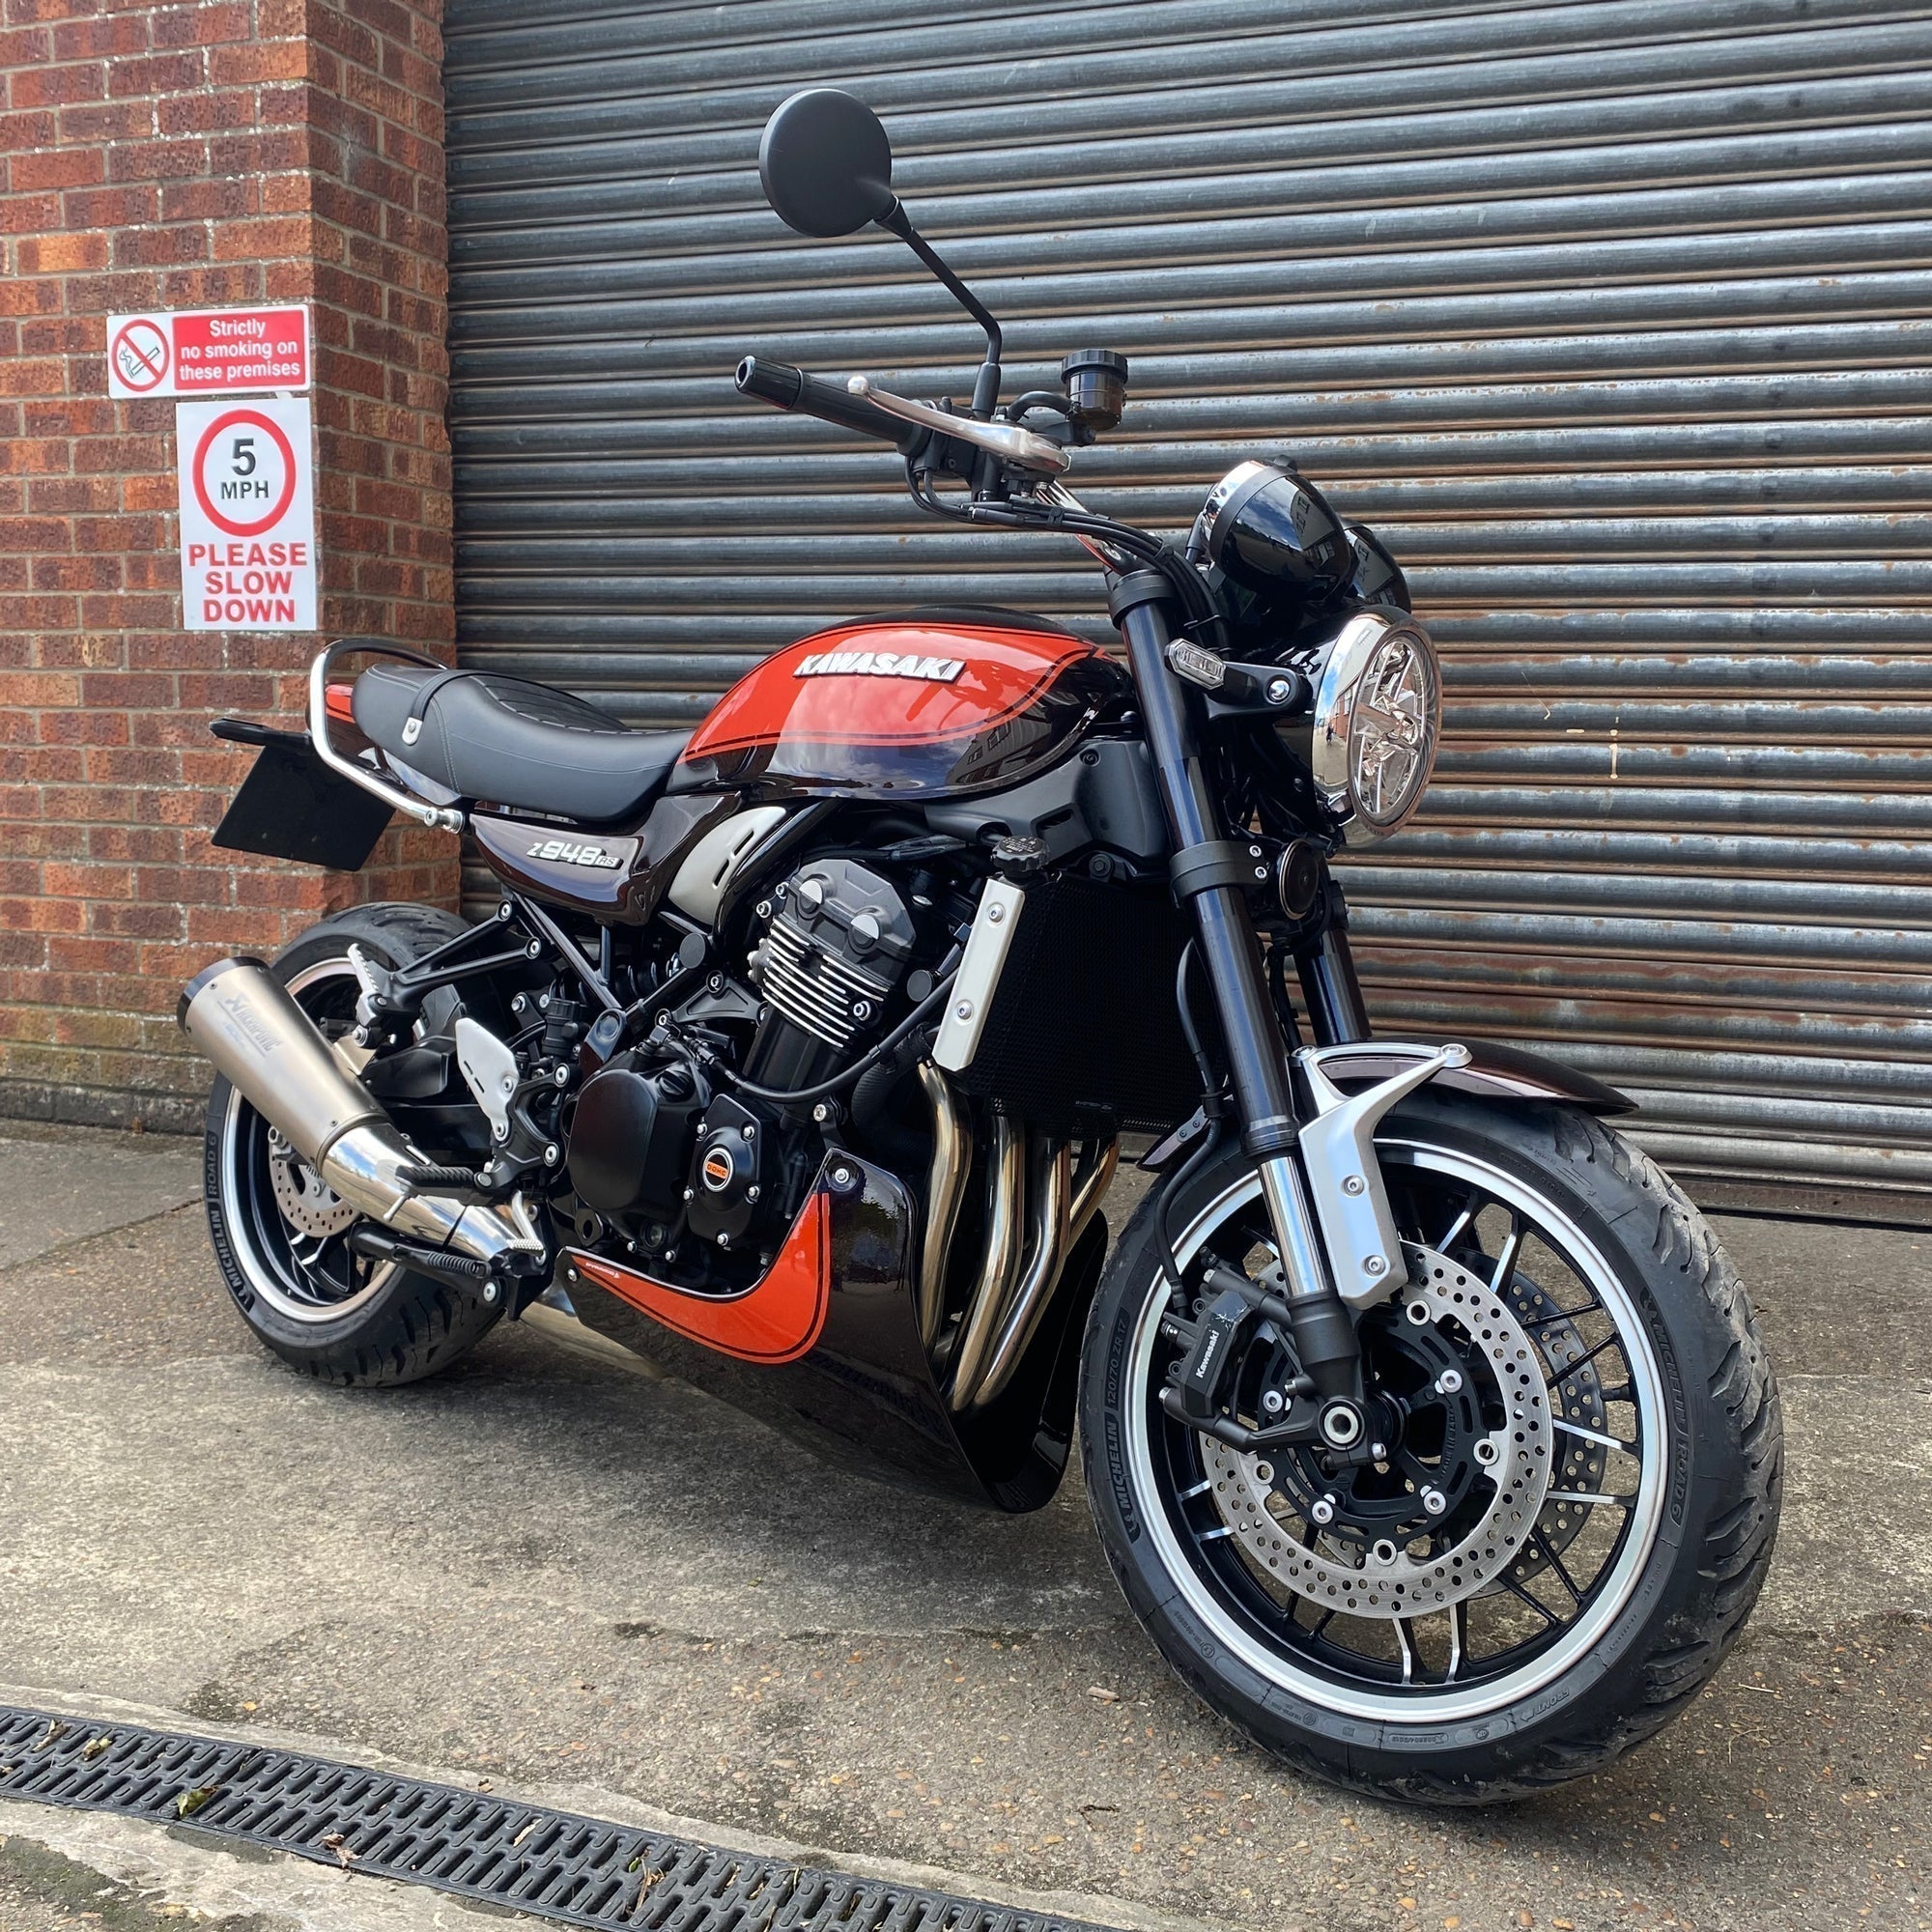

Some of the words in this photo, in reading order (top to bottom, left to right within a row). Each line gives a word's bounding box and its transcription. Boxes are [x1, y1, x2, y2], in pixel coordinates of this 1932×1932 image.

[209, 320, 266, 338] Strictly
[181, 345, 202, 360] no
[205, 340, 272, 363] smoking
[277, 341, 298, 355] on
[180, 364, 222, 381] these
[226, 361, 300, 383] premises
[231, 439, 256, 476] 5
[220, 481, 270, 500] MPH
[188, 542, 307, 567] PLEASE
[205, 570, 292, 595] SLOW
[203, 599, 296, 623] DOWN
[793, 652, 966, 684] KAWASAKI
[209, 1135, 217, 1147] 6
[208, 1150, 217, 1197] ROAD
[210, 1209, 243, 1290] MICHELIN
[1117, 1319, 1127, 1334] 17
[1112, 1336, 1123, 1354] ZR
[1196, 1329, 1220, 1378] Kawasaki
[1108, 1356, 1121, 1407] 120/70
[1653, 1322, 1687, 1427] MICHELIN
[1675, 1442, 1689, 1499] ROAD
[1107, 1420, 1131, 1510] MICHELIN
[1532, 1689, 1571, 1717] FRONT
